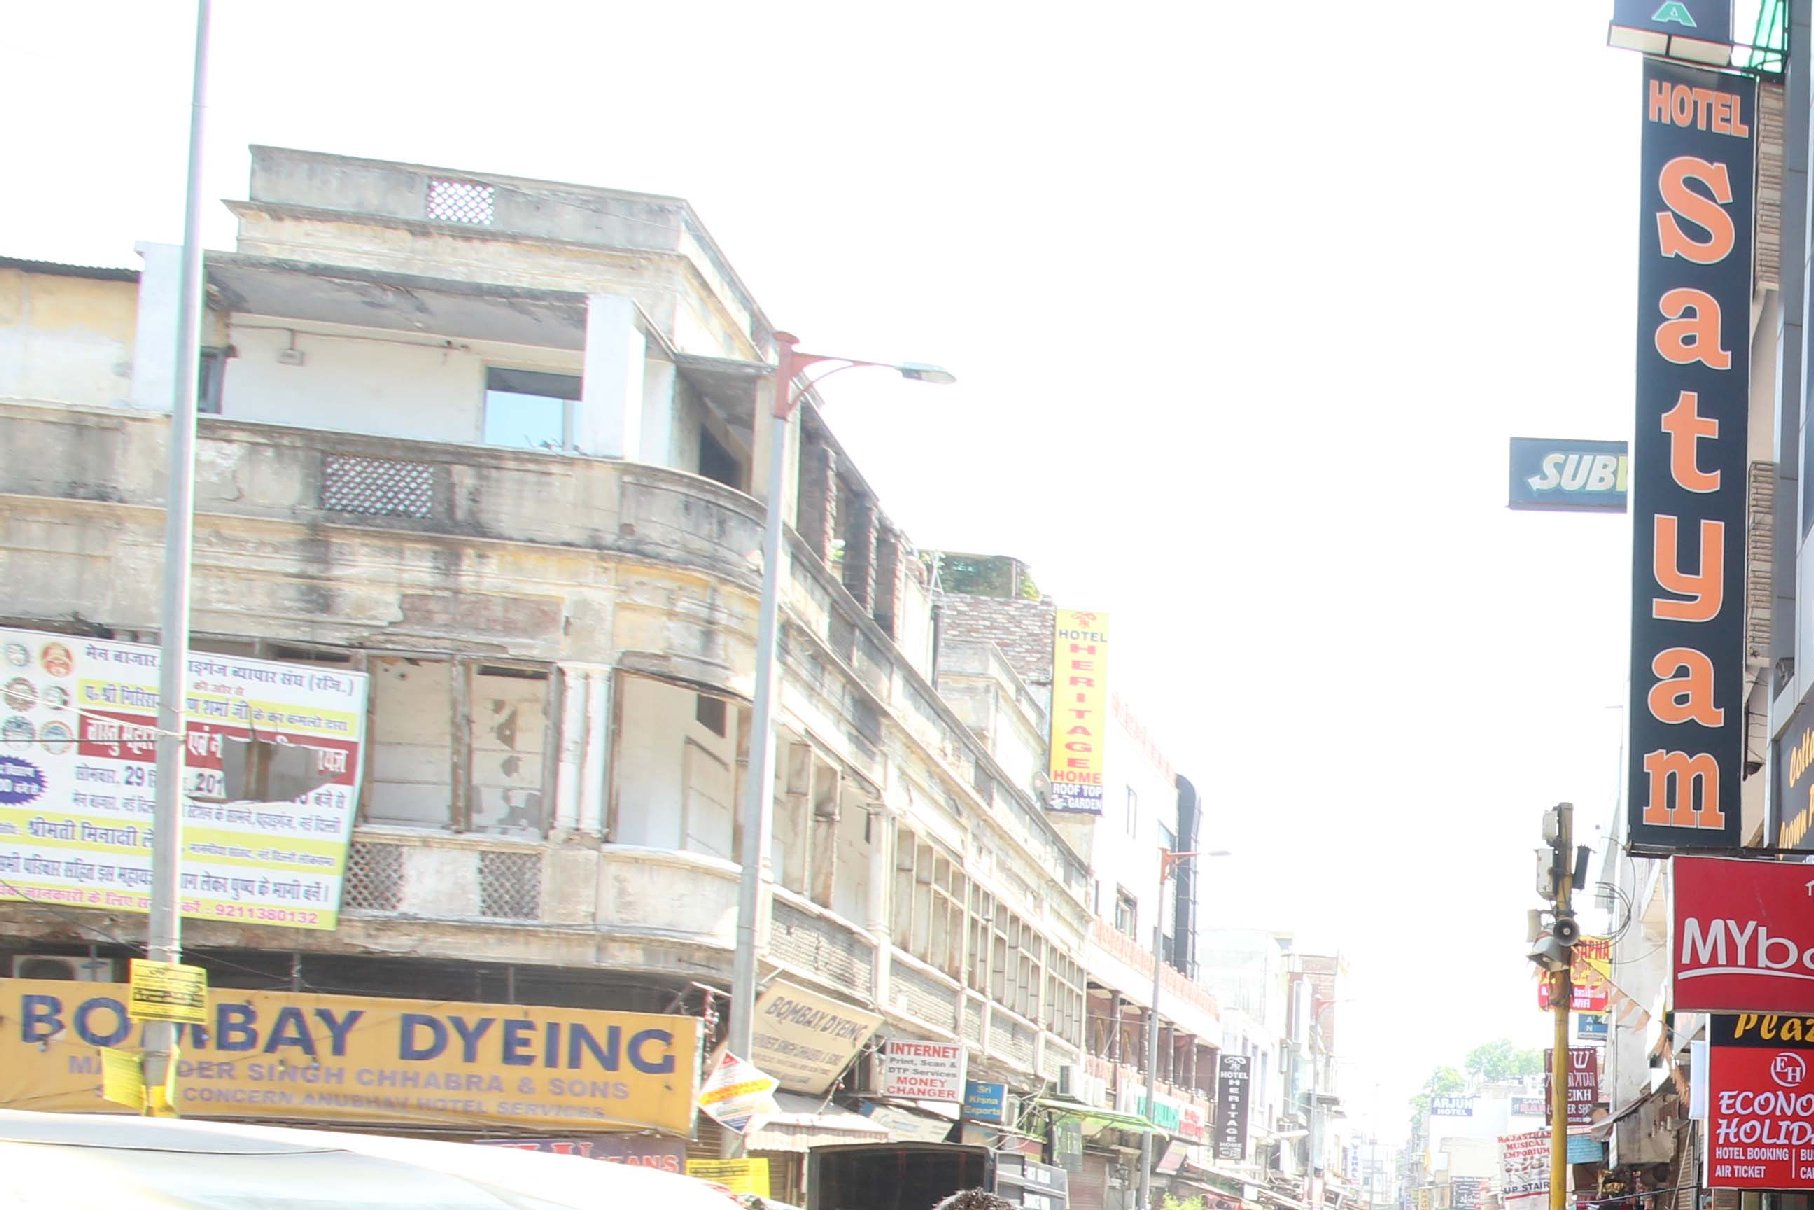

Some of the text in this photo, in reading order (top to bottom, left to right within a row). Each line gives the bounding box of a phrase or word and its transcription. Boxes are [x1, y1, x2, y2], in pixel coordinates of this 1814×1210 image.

[1648, 79, 1749, 138] HOTEL
[1058, 628, 1108, 643] HOTEL
[1065, 644, 1096, 769] HERITAGE
[124, 765, 146, 787] 29
[1053, 769, 1101, 785] HOME
[1053, 784, 1103, 797] ROOF TOP
[765, 996, 869, 1044] BOMBAY DYEING
[399, 1012, 676, 1075] DYEING
[890, 1042, 960, 1059] INTERNET
[889, 1057, 918, 1067] Print,
[921, 1058, 946, 1068] Scan
[912, 1068, 957, 1078] Services
[1220, 1071, 1249, 1080] HOTEL
[248, 1062, 630, 1100] SINGH CHHABRA & SONS
[896, 1076, 948, 1088] MONEY
[887, 1085, 957, 1099] CHANGER
[182, 1087, 294, 1105] CONCERN
[418, 1096, 488, 1114] HOTEL
[496, 1102, 605, 1119] SERVICES
[1507, 1140, 1546, 1150] MUSICAL
[1504, 1148, 1550, 1159] EMPORIUM
[1715, 1147, 1790, 1161] HOTEL BOOKING
[1715, 1165, 1766, 1178] AIR TICKET
[1504, 1184, 1519, 1194] UP
